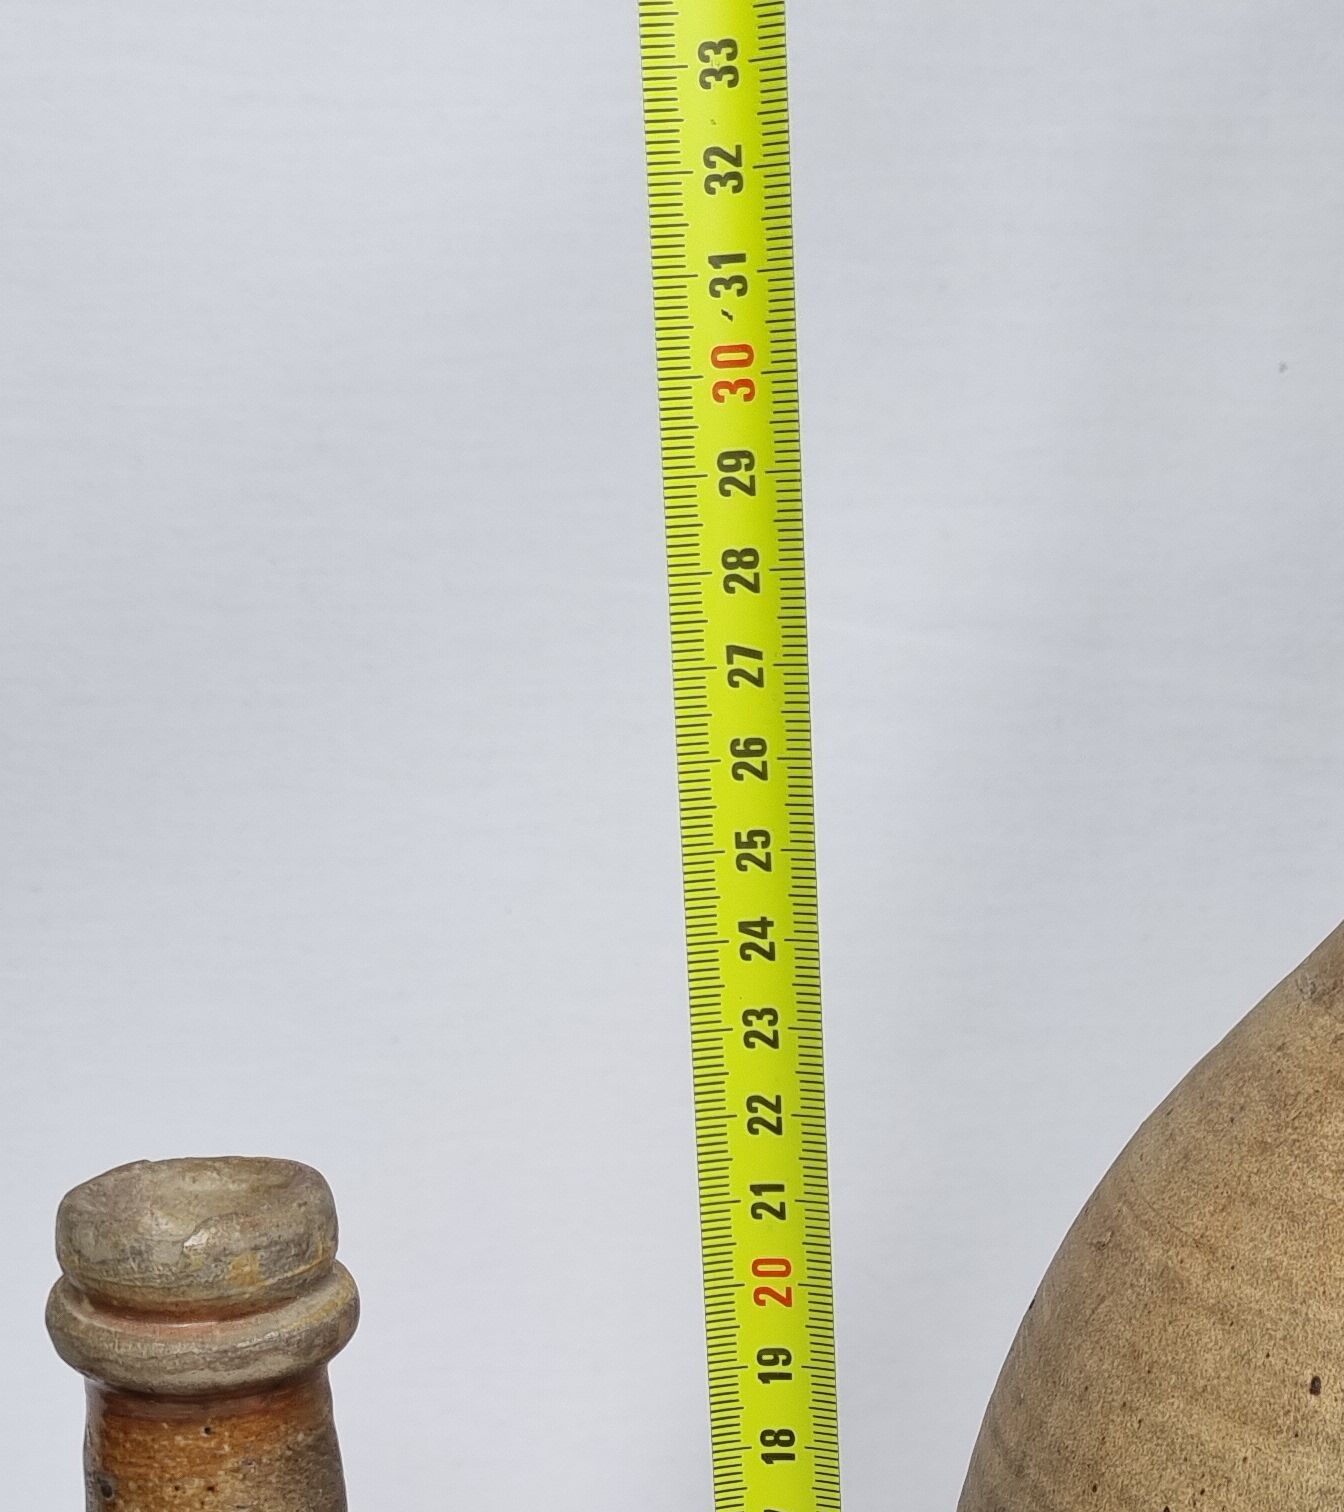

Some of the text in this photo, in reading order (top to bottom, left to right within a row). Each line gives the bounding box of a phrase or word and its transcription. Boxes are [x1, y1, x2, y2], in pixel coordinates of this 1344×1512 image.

[698, 39, 739, 89] 33
[703, 145, 743, 195] 32
[708, 253, 748, 299] 31
[711, 344, 755, 404] 30
[717, 450, 756, 498] 29
[721, 548, 760, 595] 28
[726, 645, 764, 689] 27
[730, 737, 768, 781] 26
[735, 829, 772, 873] 25
[738, 916, 775, 962] 24
[742, 1007, 779, 1050] 23
[746, 1094, 783, 1136] 22
[750, 1183, 786, 1221] 21
[752, 1257, 792, 1308] 20
[757, 1347, 793, 1385] 19
[760, 1428, 796, 1465] 18
